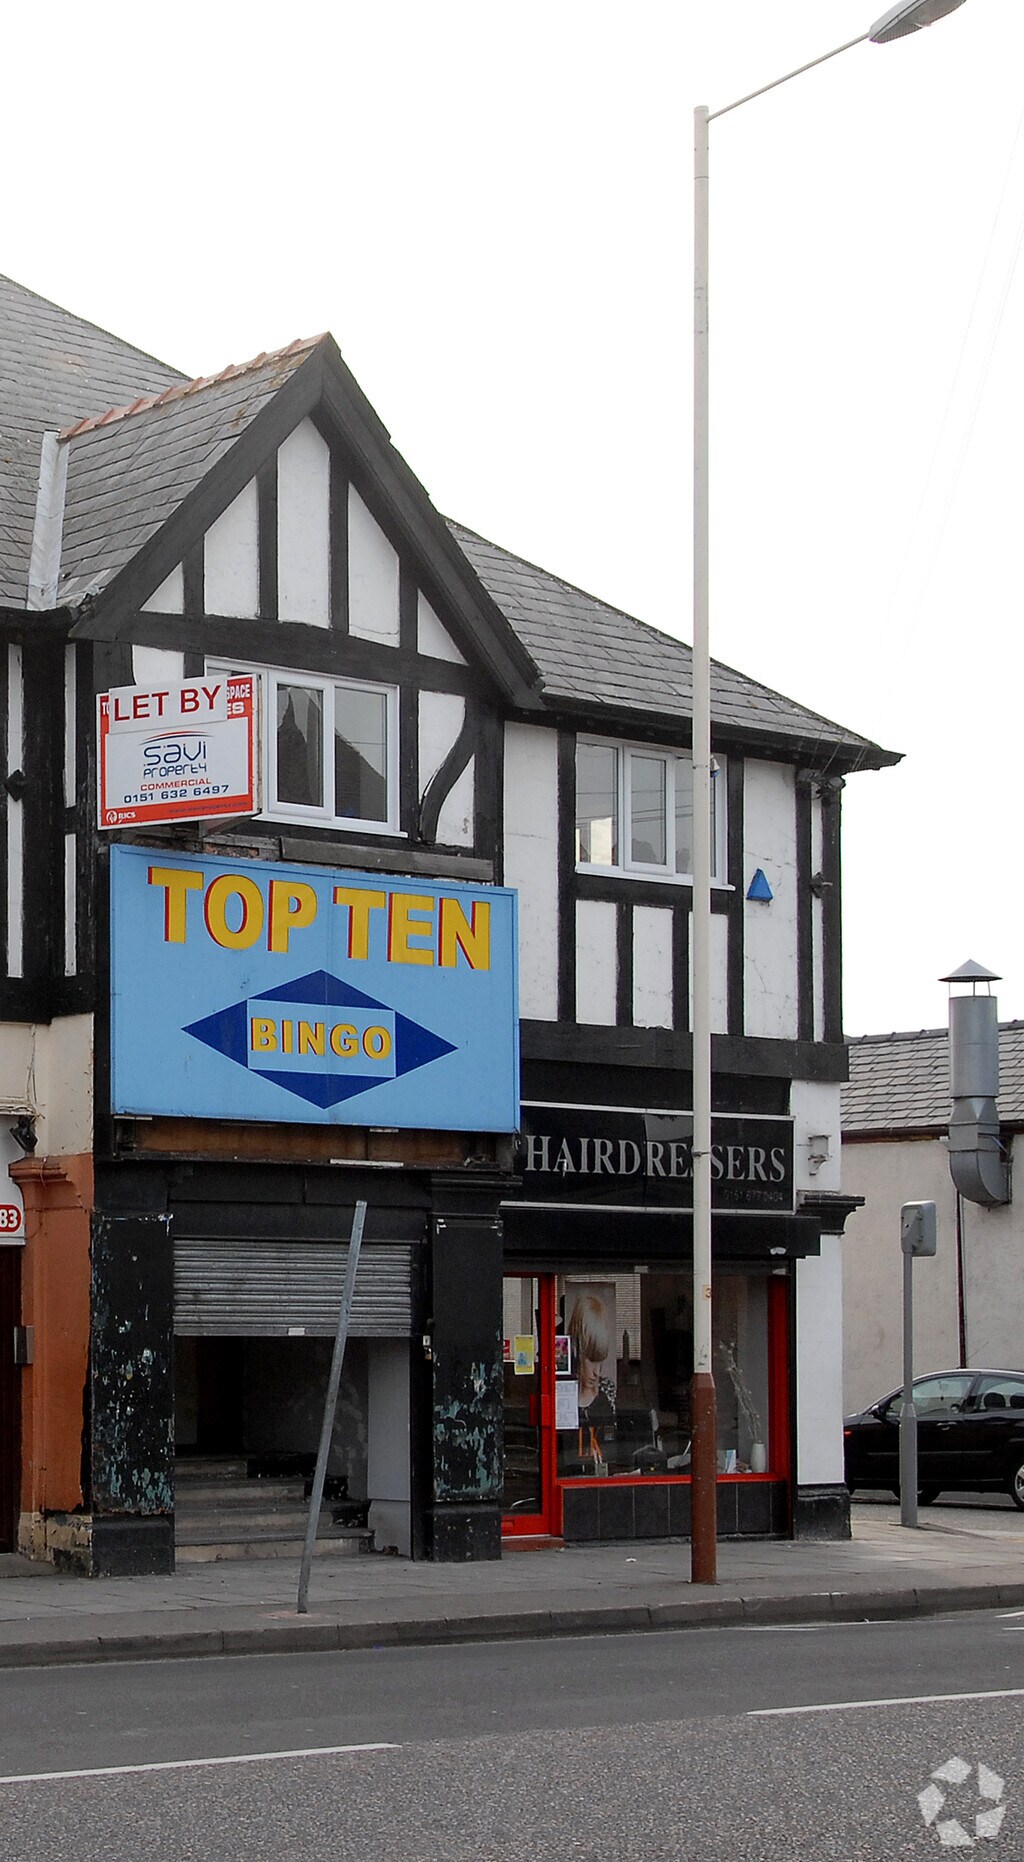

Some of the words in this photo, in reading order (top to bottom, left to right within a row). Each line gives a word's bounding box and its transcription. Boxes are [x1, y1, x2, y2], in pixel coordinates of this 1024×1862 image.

[114, 691, 169, 722] LET
[180, 685, 222, 714] BY
[124, 792, 154, 804] 0151
[161, 789, 188, 800] 632
[193, 784, 230, 797] 6497
[140, 777, 212, 792] COMMERCIAL
[147, 865, 318, 953] TOP
[333, 886, 491, 972] TEN
[251, 1016, 392, 1061] BINGO
[525, 1134, 786, 1182] HAIRDRESERS
